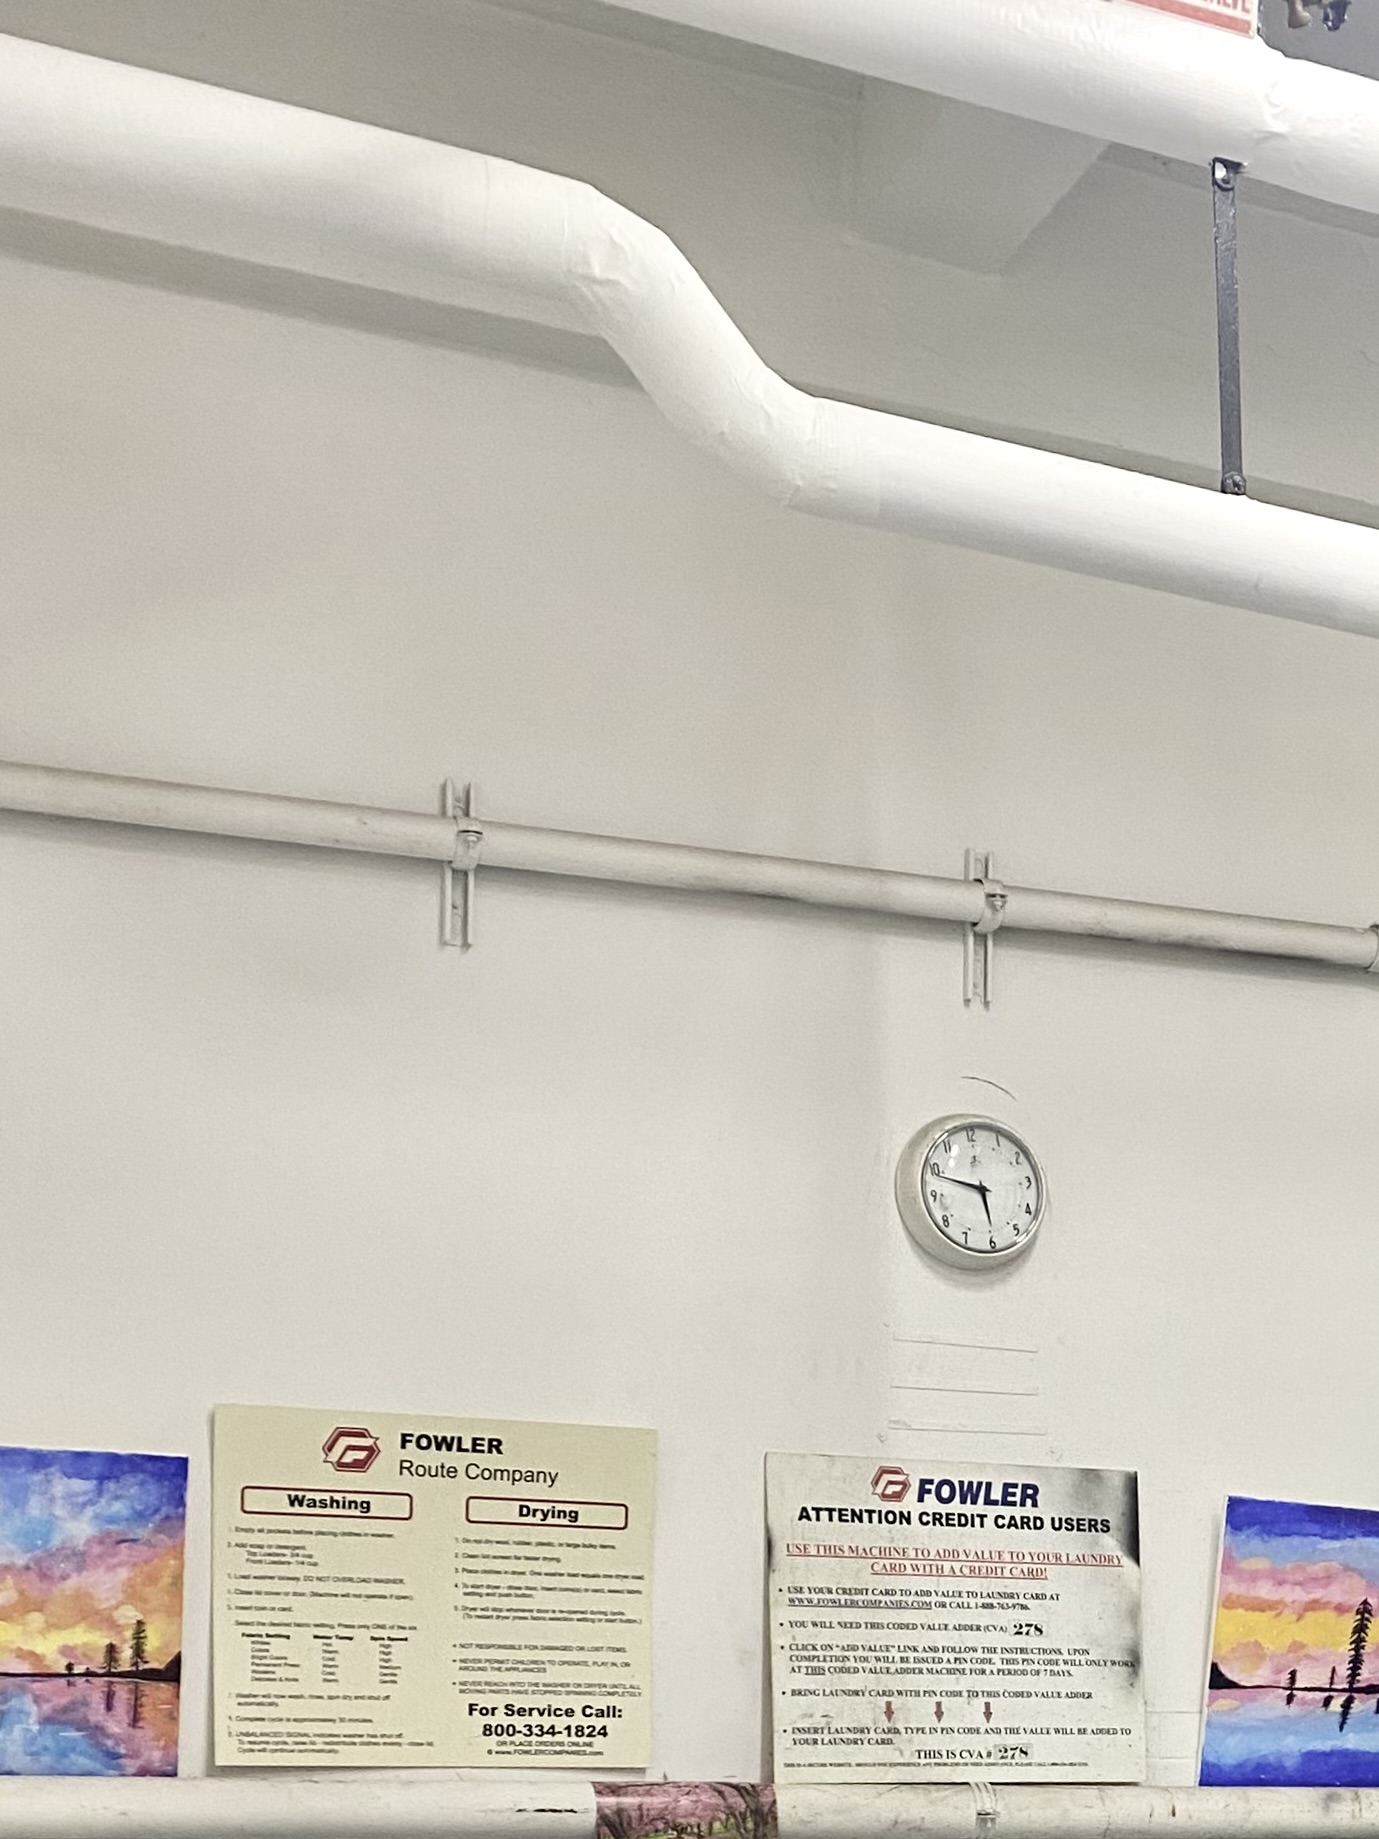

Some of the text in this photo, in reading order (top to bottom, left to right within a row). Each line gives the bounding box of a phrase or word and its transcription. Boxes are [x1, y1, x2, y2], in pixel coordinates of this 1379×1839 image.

[966, 1128, 976, 1142] 12
[995, 1130, 1001, 1147] 1
[942, 1139, 951, 1153] 11
[1014, 1151, 1021, 1165] 2
[929, 1162, 940, 1176] 10
[1025, 1176, 1032, 1190] 3
[931, 1190, 937, 1202] 9
[1025, 1203, 1032, 1216] 4
[942, 1215, 950, 1228] 8
[1013, 1224, 1020, 1236] 5
[962, 1232, 969, 1244] 7
[989, 1235, 997, 1249] 6
[399, 1433, 504, 1455] FOWLER
[399, 1460, 559, 1486] Route Company
[917, 1479, 1039, 1508] FOWLER
[287, 1494, 372, 1514] Washing
[518, 1505, 579, 1522] Drying
[797, 1506, 1110, 1534] ATTENTION CREDIT CARD USERS
[786, 1544, 1123, 1565] USE THIS MACHINE TO ADD VALUE TO YOUR LAUNDRY
[870, 1562, 1047, 1577] CARD WITH A CREDIT CARD!
[787, 1586, 805, 1595] USE
[806, 1587, 833, 1595] YOUR
[835, 1587, 869, 1596] CREDIT
[871, 1588, 897, 1597] CARD
[897, 1589, 912, 1597] TO
[912, 1589, 932, 1598] ADD
[933, 1590, 964, 1598] VALUE
[964, 1591, 978, 1599] TO
[979, 1591, 1021, 1600] LAUNDRY
[1048, 1593, 1060, 1601] AT
[788, 1621, 1044, 1636] YOU WILL NEED THIS CODED VALUE ADDER (CVA) 278
[789, 1643, 819, 1652] CLICK
[820, 1644, 833, 1652] ON
[897, 1645, 919, 1653] LINK
[920, 1645, 940, 1653] AND
[941, 1646, 978, 1654] FOLLOW
[980, 1646, 998, 1654] THE
[1067, 1647, 1090, 1656] UPON
[789, 1655, 850, 1664] COMPLETION
[852, 1656, 872, 1664] YOU
[873, 1656, 898, 1664] WILL
[899, 1657, 911, 1665] BE
[912, 1657, 943, 1665] ISSUED
[945, 1657, 952, 1665] A
[999, 1658, 1020, 1666] THIS
[1036, 1659, 1060, 1667] CODE
[1062, 1659, 1084, 1667] WILL
[1109, 1660, 1136, 1668] WORK
[789, 1666, 803, 1674] AT
[805, 1666, 826, 1674] THIS
[827, 1666, 859, 1674] CODED
[860, 1667, 892, 1675] VALUE
[892, 1667, 924, 1675] ADDER
[925, 1667, 967, 1676] MACHINE
[968, 1668, 987, 1676] FOR
[988, 1668, 995, 1676] A
[996, 1668, 1028, 1676] PERIOD
[1043, 1669, 1047, 1677] 7
[791, 1689, 820, 1697] BRING
[822, 1689, 867, 1697] LAUNDRY
[895, 1690, 921, 1698] WITH
[922, 1690, 937, 1698] PIN
[939, 1690, 964, 1698] CODE
[965, 1690, 979, 1698] TO
[1001, 1691, 1032, 1699] CODED
[1033, 1691, 1063, 1699] VALUE
[1063, 1691, 1093, 1699] ADDER
[468, 1703, 623, 1718] For Service Call:
[482, 1724, 609, 1738] 800-334-1824
[792, 1727, 826, 1735] INSERT
[827, 1727, 871, 1735] LAUNDRY
[903, 1727, 927, 1735] TYPE
[928, 1727, 938, 1735] IN
[940, 1727, 955, 1735] PIN
[820, 1738, 866, 1746] LAUNDRY
[867, 1738, 895, 1746] CARD.
[915, 1750, 943, 1759] THIS
[945, 1750, 956, 1759] IS
[958, 1750, 983, 1759] CVA
[998, 1747, 1029, 1760] 278
